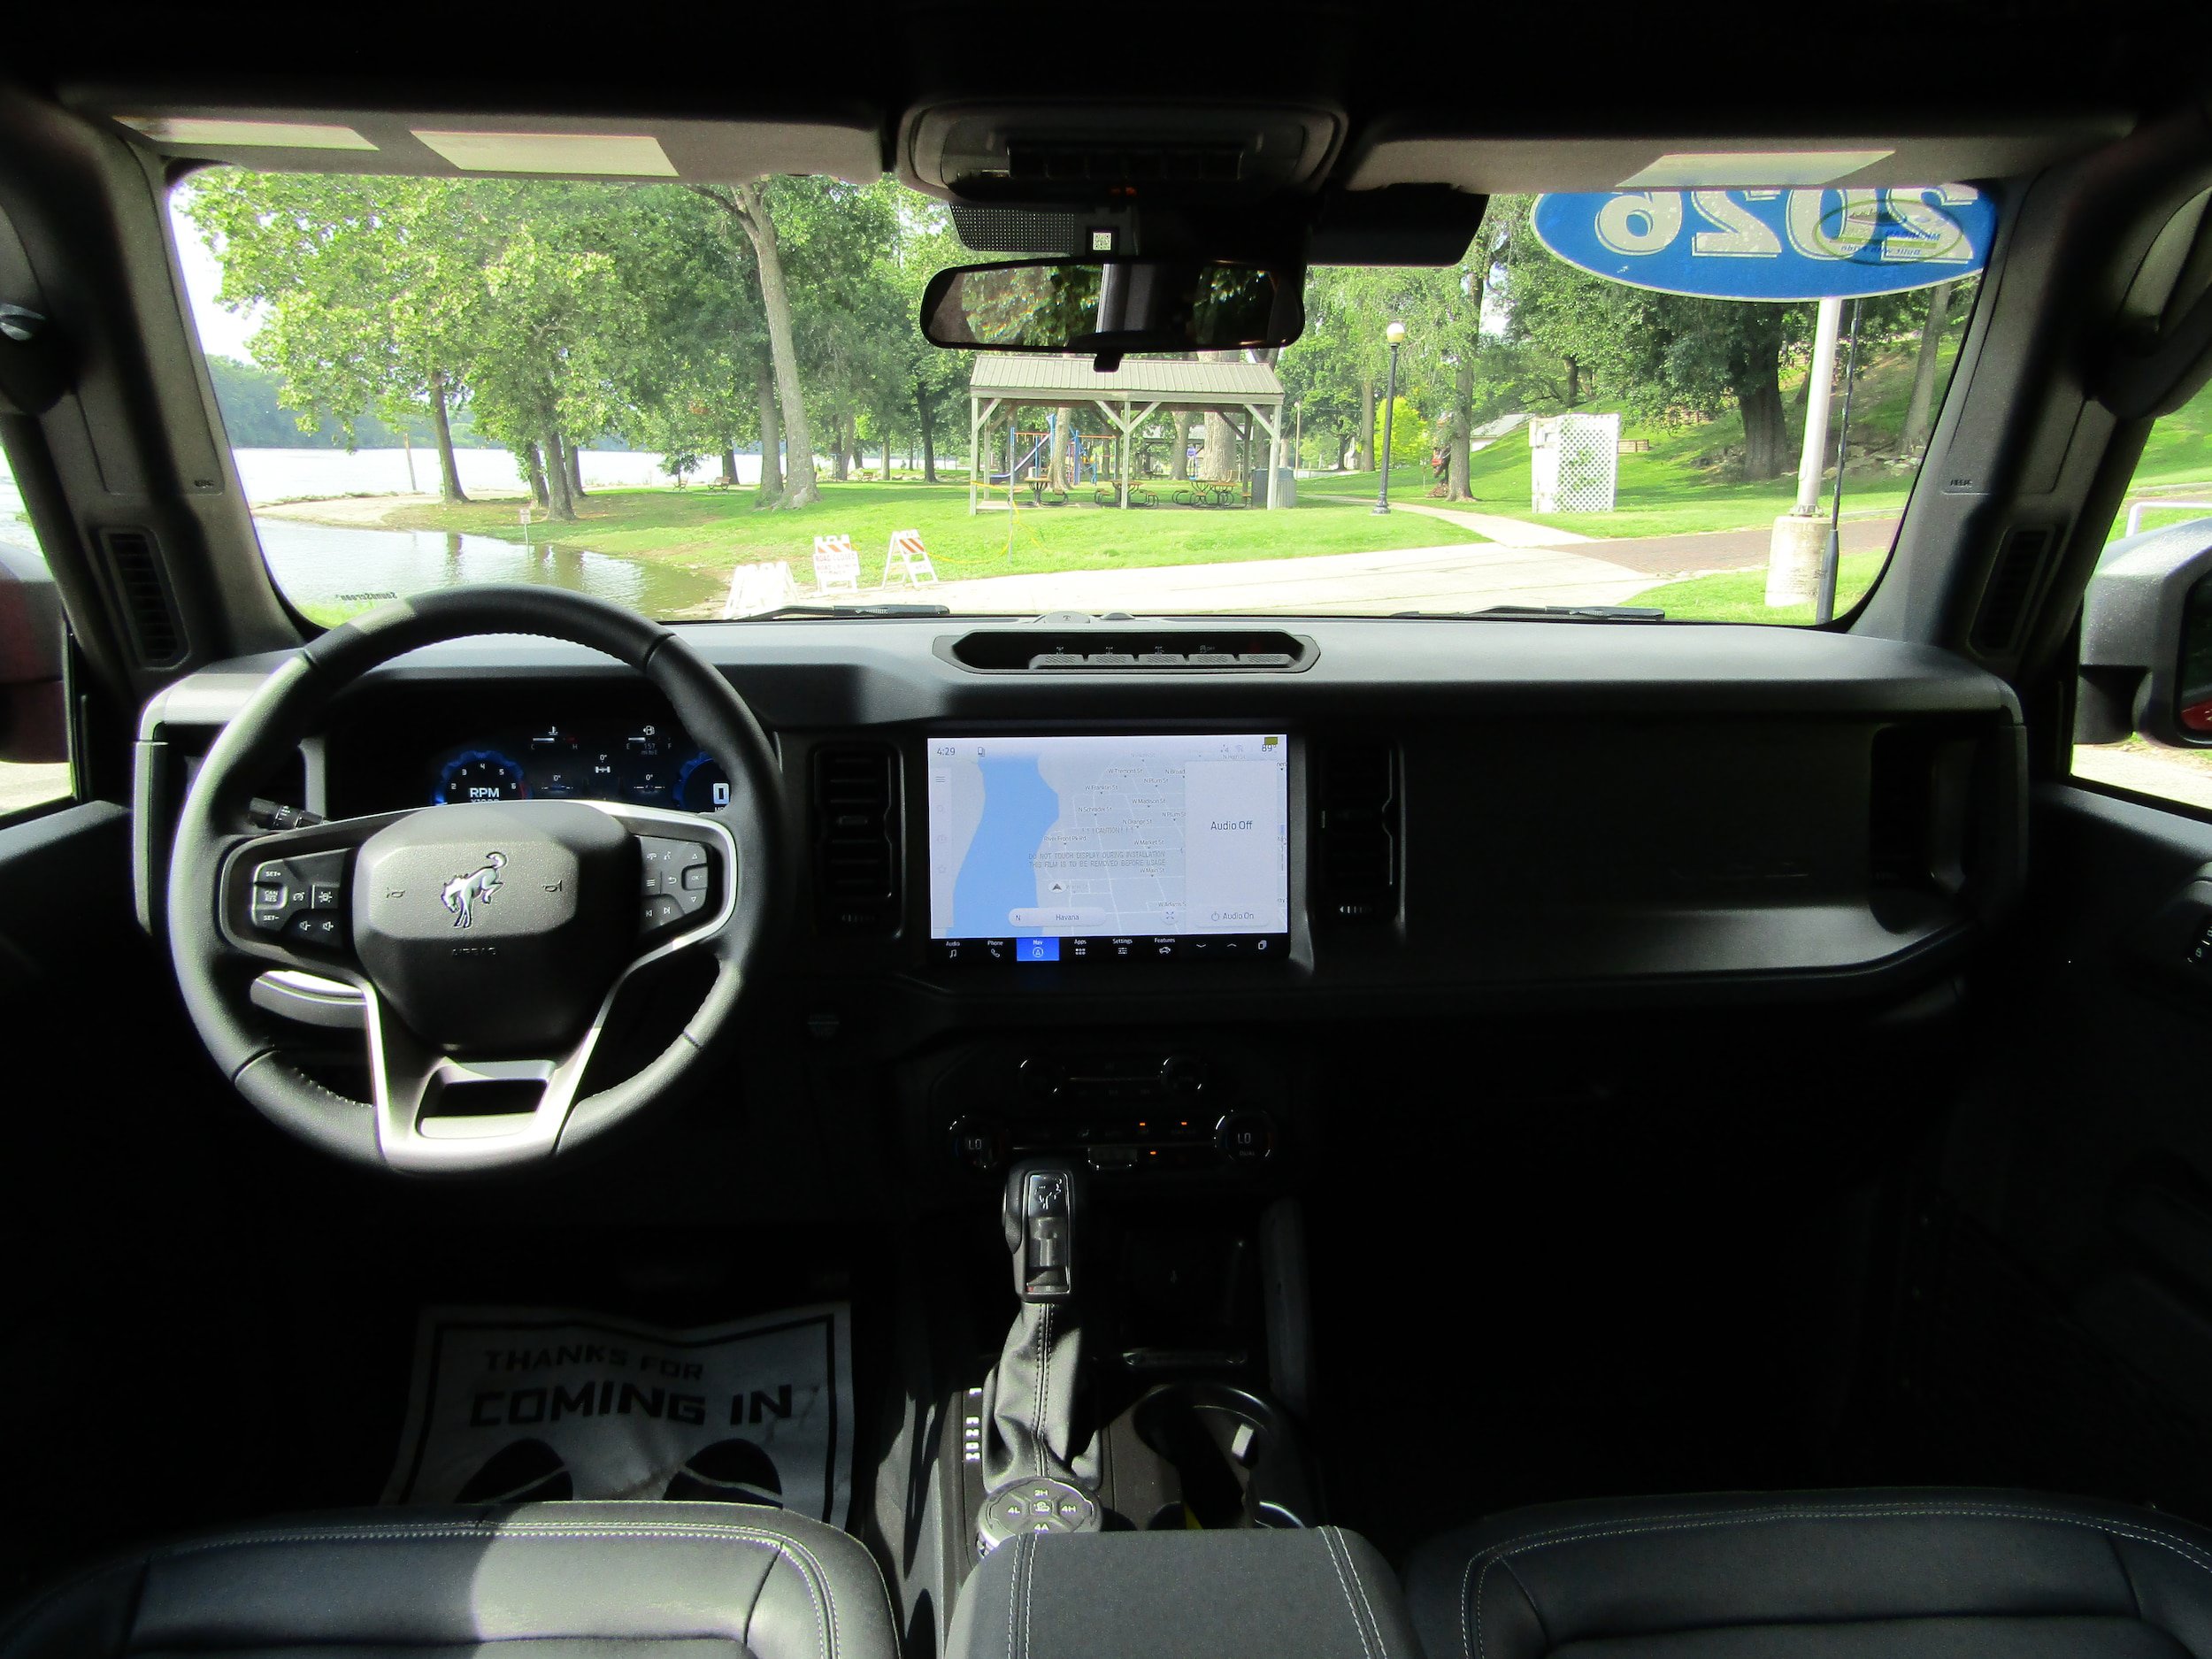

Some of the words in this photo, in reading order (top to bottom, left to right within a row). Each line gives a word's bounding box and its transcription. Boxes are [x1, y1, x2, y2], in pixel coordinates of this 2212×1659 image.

[937, 747, 956, 756] 4:29
[470, 787, 500, 797] RPM
[713, 783, 729, 804] 0
[1210, 820, 1234, 831] Audio
[1236, 820, 1253, 831] Off
[1237, 1133, 1252, 1144] LO
[969, 1139, 982, 1150] LO
[484, 1344, 629, 1372] THANKS
[639, 1355, 704, 1381] FOR
[469, 1382, 706, 1426] COMING
[729, 1384, 793, 1425] IN
